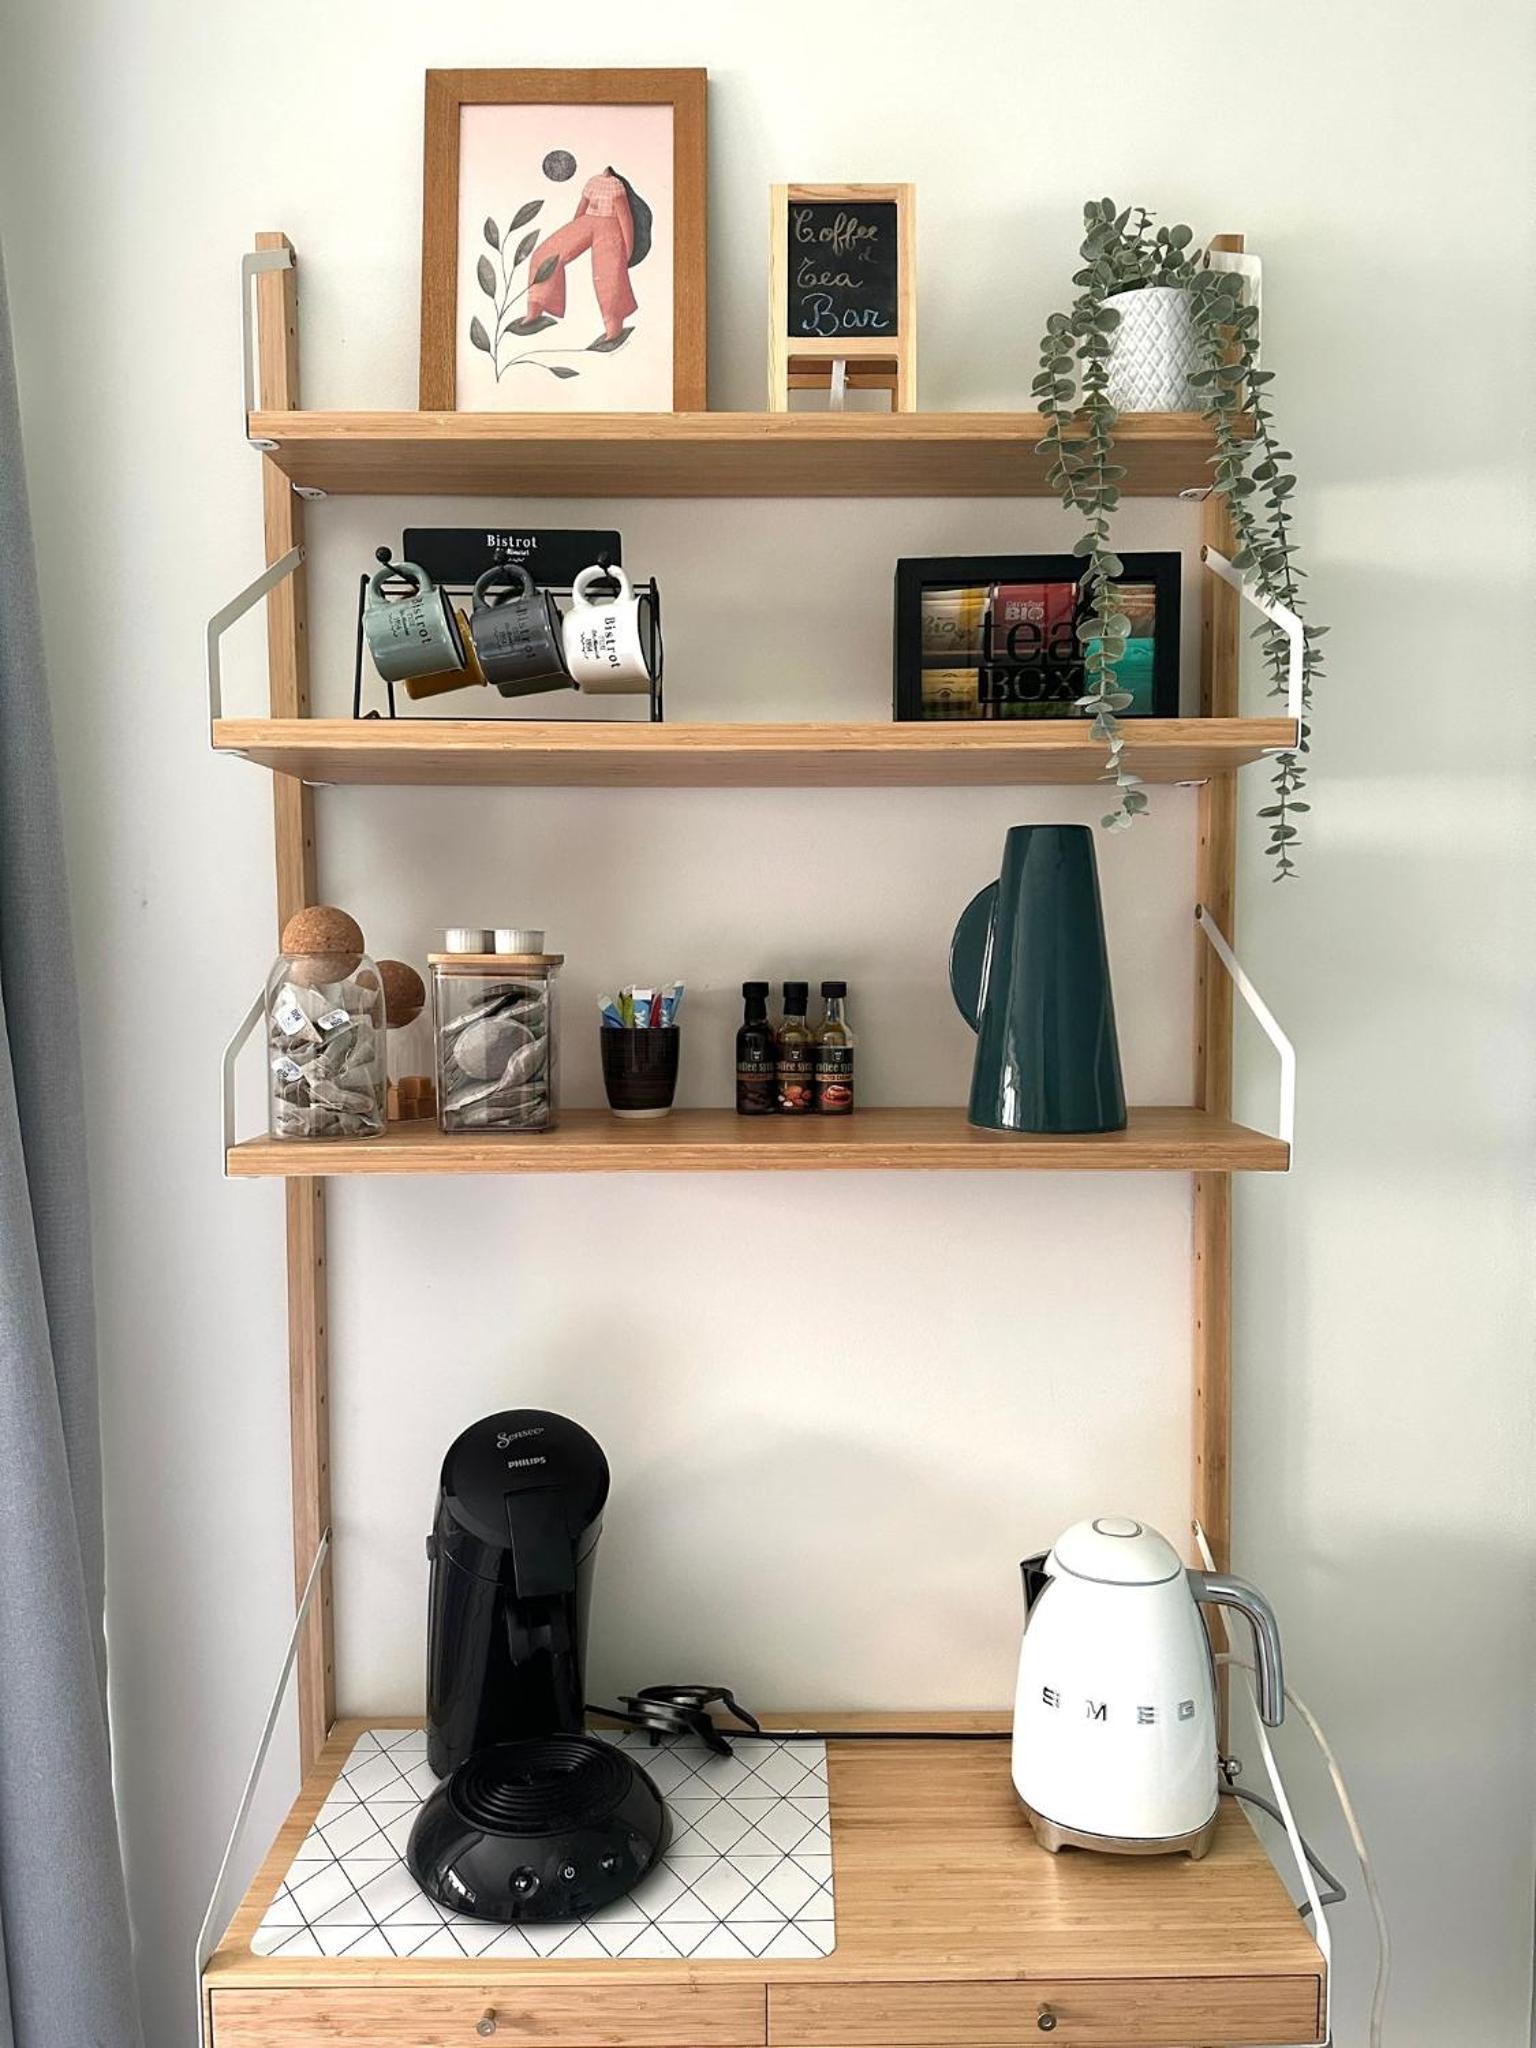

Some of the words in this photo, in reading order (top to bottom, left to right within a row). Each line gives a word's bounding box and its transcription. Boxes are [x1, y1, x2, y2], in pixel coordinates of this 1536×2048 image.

[794, 209, 878, 256] Coffee
[797, 257, 864, 288] Tea
[801, 292, 890, 336] Bar
[487, 534, 538, 548] Bistrot
[1004, 606, 1045, 621] BIO
[604, 616, 621, 669] Bistrot
[977, 611, 1087, 664] tea
[983, 667, 1082, 700] BOX
[496, 1427, 544, 1449] Senseo
[508, 1456, 547, 1468] PHILIPS
[1042, 1686, 1195, 1722] SMEG
